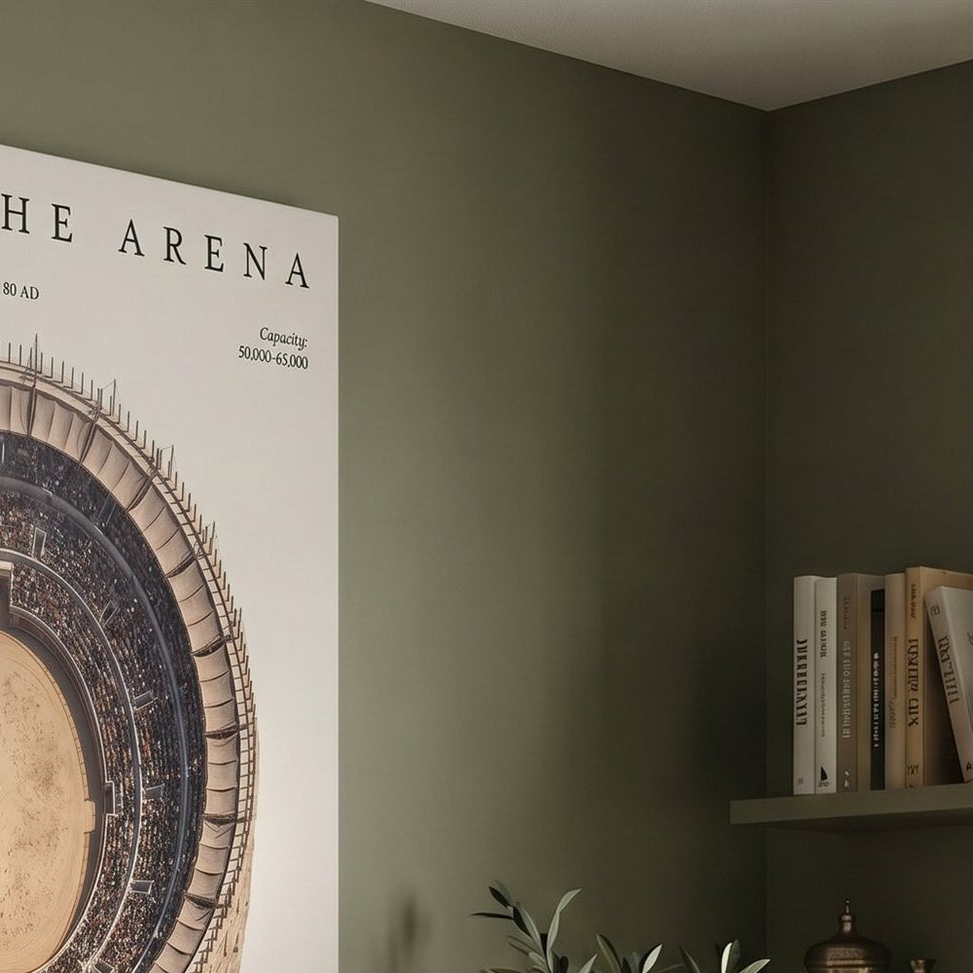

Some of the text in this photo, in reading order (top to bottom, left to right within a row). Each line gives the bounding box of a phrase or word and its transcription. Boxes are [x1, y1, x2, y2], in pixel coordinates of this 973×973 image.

[118, 219, 310, 289] ARENA
[3, 282, 17, 296] 80
[20, 284, 39, 300] AD
[260, 327, 308, 350] Capacity:
